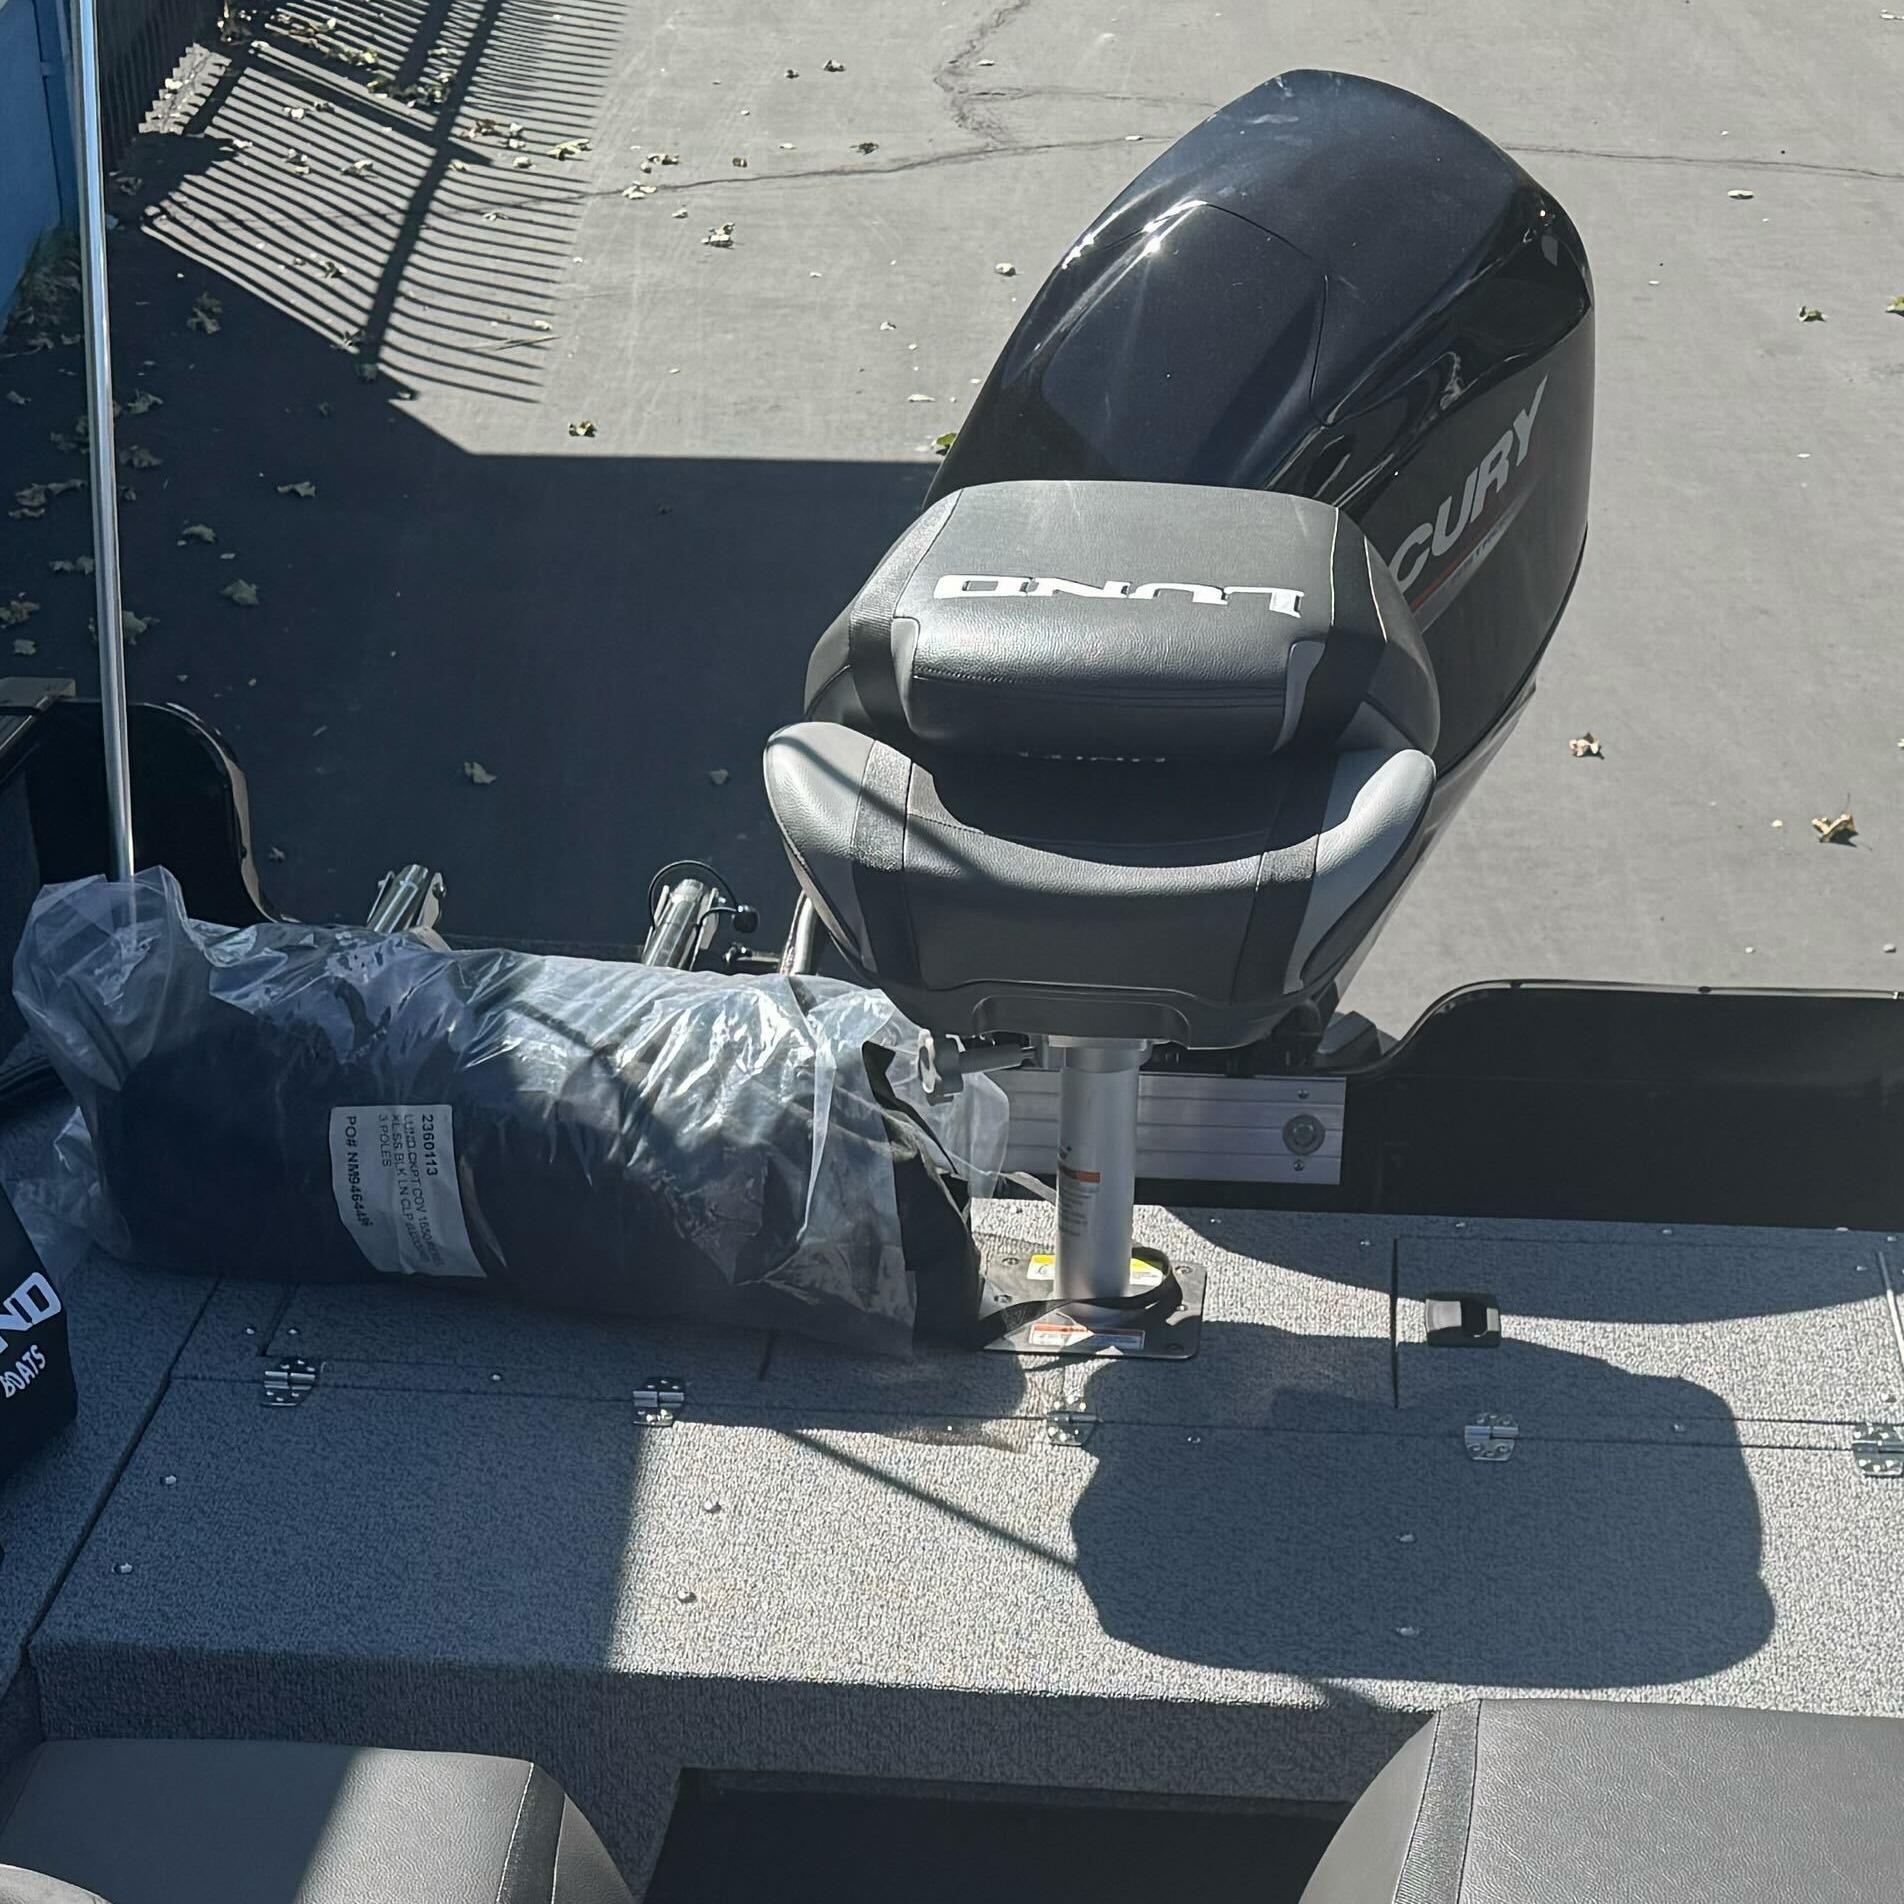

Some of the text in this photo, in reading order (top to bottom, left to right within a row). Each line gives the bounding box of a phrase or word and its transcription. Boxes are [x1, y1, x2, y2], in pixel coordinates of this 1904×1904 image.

[1388, 374, 1549, 596] CURY
[932, 573, 1305, 619] LUND
[345, 1116, 357, 1148] PO#
[379, 1125, 392, 1167] POLES
[422, 1113, 439, 1177] 2360113
[395, 1152, 407, 1177] BLK
